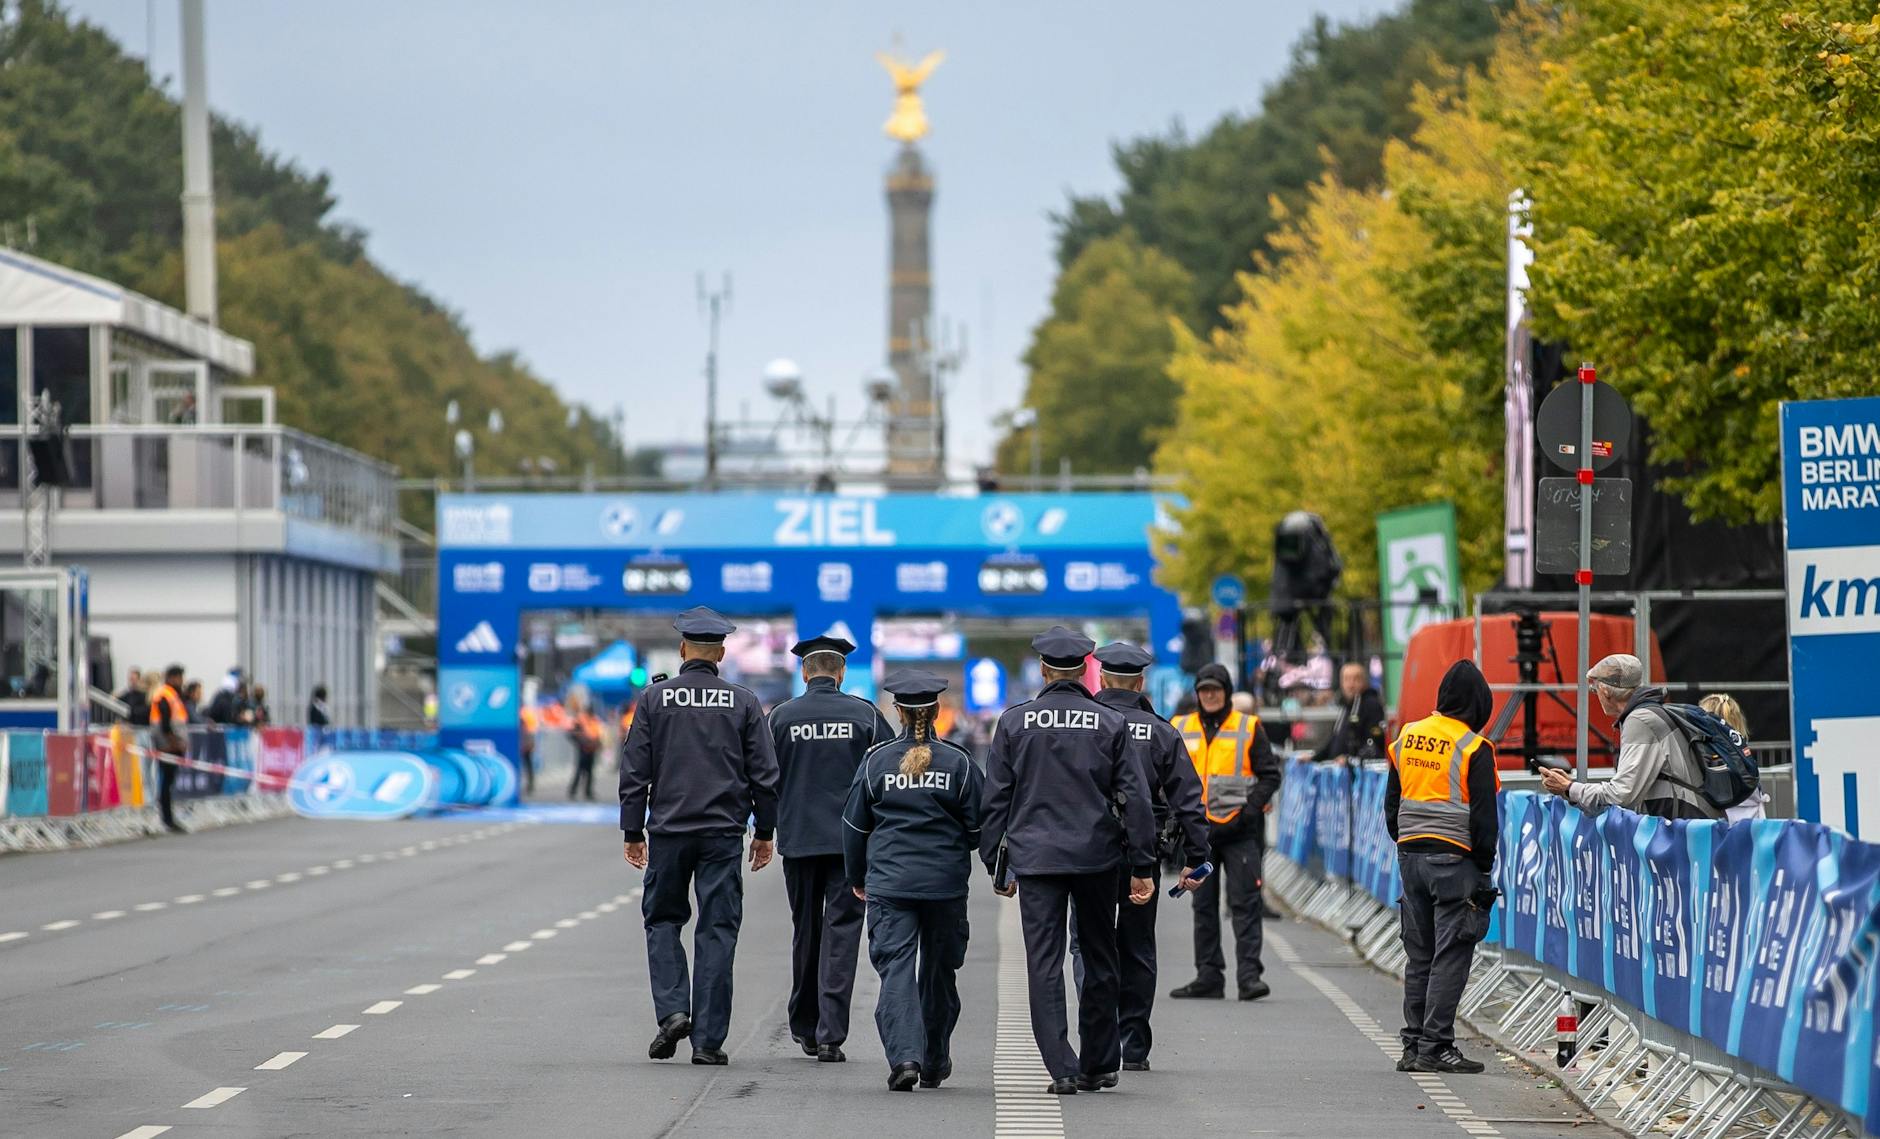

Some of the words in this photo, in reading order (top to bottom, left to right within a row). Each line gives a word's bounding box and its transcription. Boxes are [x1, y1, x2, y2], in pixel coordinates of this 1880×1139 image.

[1800, 423, 1880, 458] BMW
[774, 499, 896, 546] ZIEL
[1800, 564, 1880, 618] km
[662, 687, 735, 708] POLIZEI
[1024, 709, 1099, 730] POLIZEI
[790, 722, 853, 742] POLIZEI
[1406, 757, 1441, 771] STEWARD
[884, 771, 951, 791] POLIZEI
